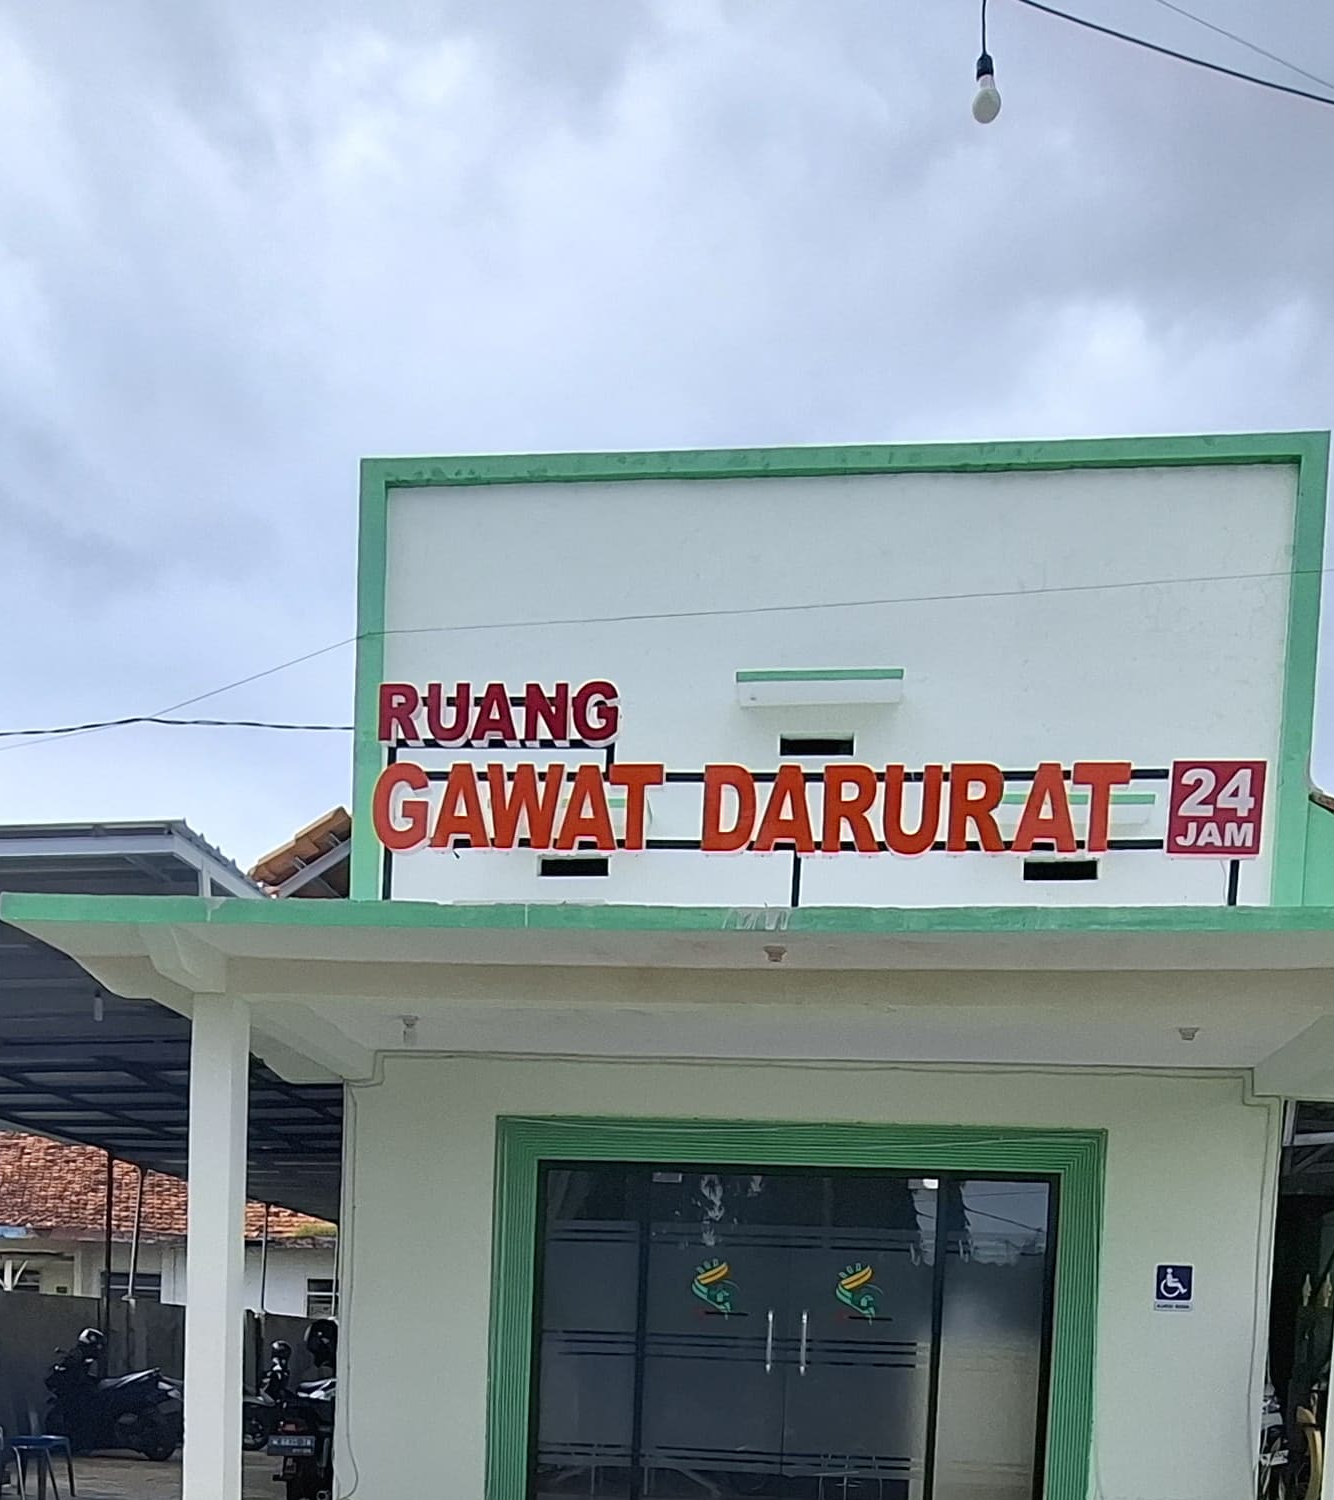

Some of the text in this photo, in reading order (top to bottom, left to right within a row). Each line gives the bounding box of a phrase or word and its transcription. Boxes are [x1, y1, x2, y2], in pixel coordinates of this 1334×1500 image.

[377, 680, 620, 744] RUANG
[372, 761, 1133, 855] GAWAT DARURAT
[1177, 767, 1255, 817] 24
[1175, 822, 1254, 847] JAM
